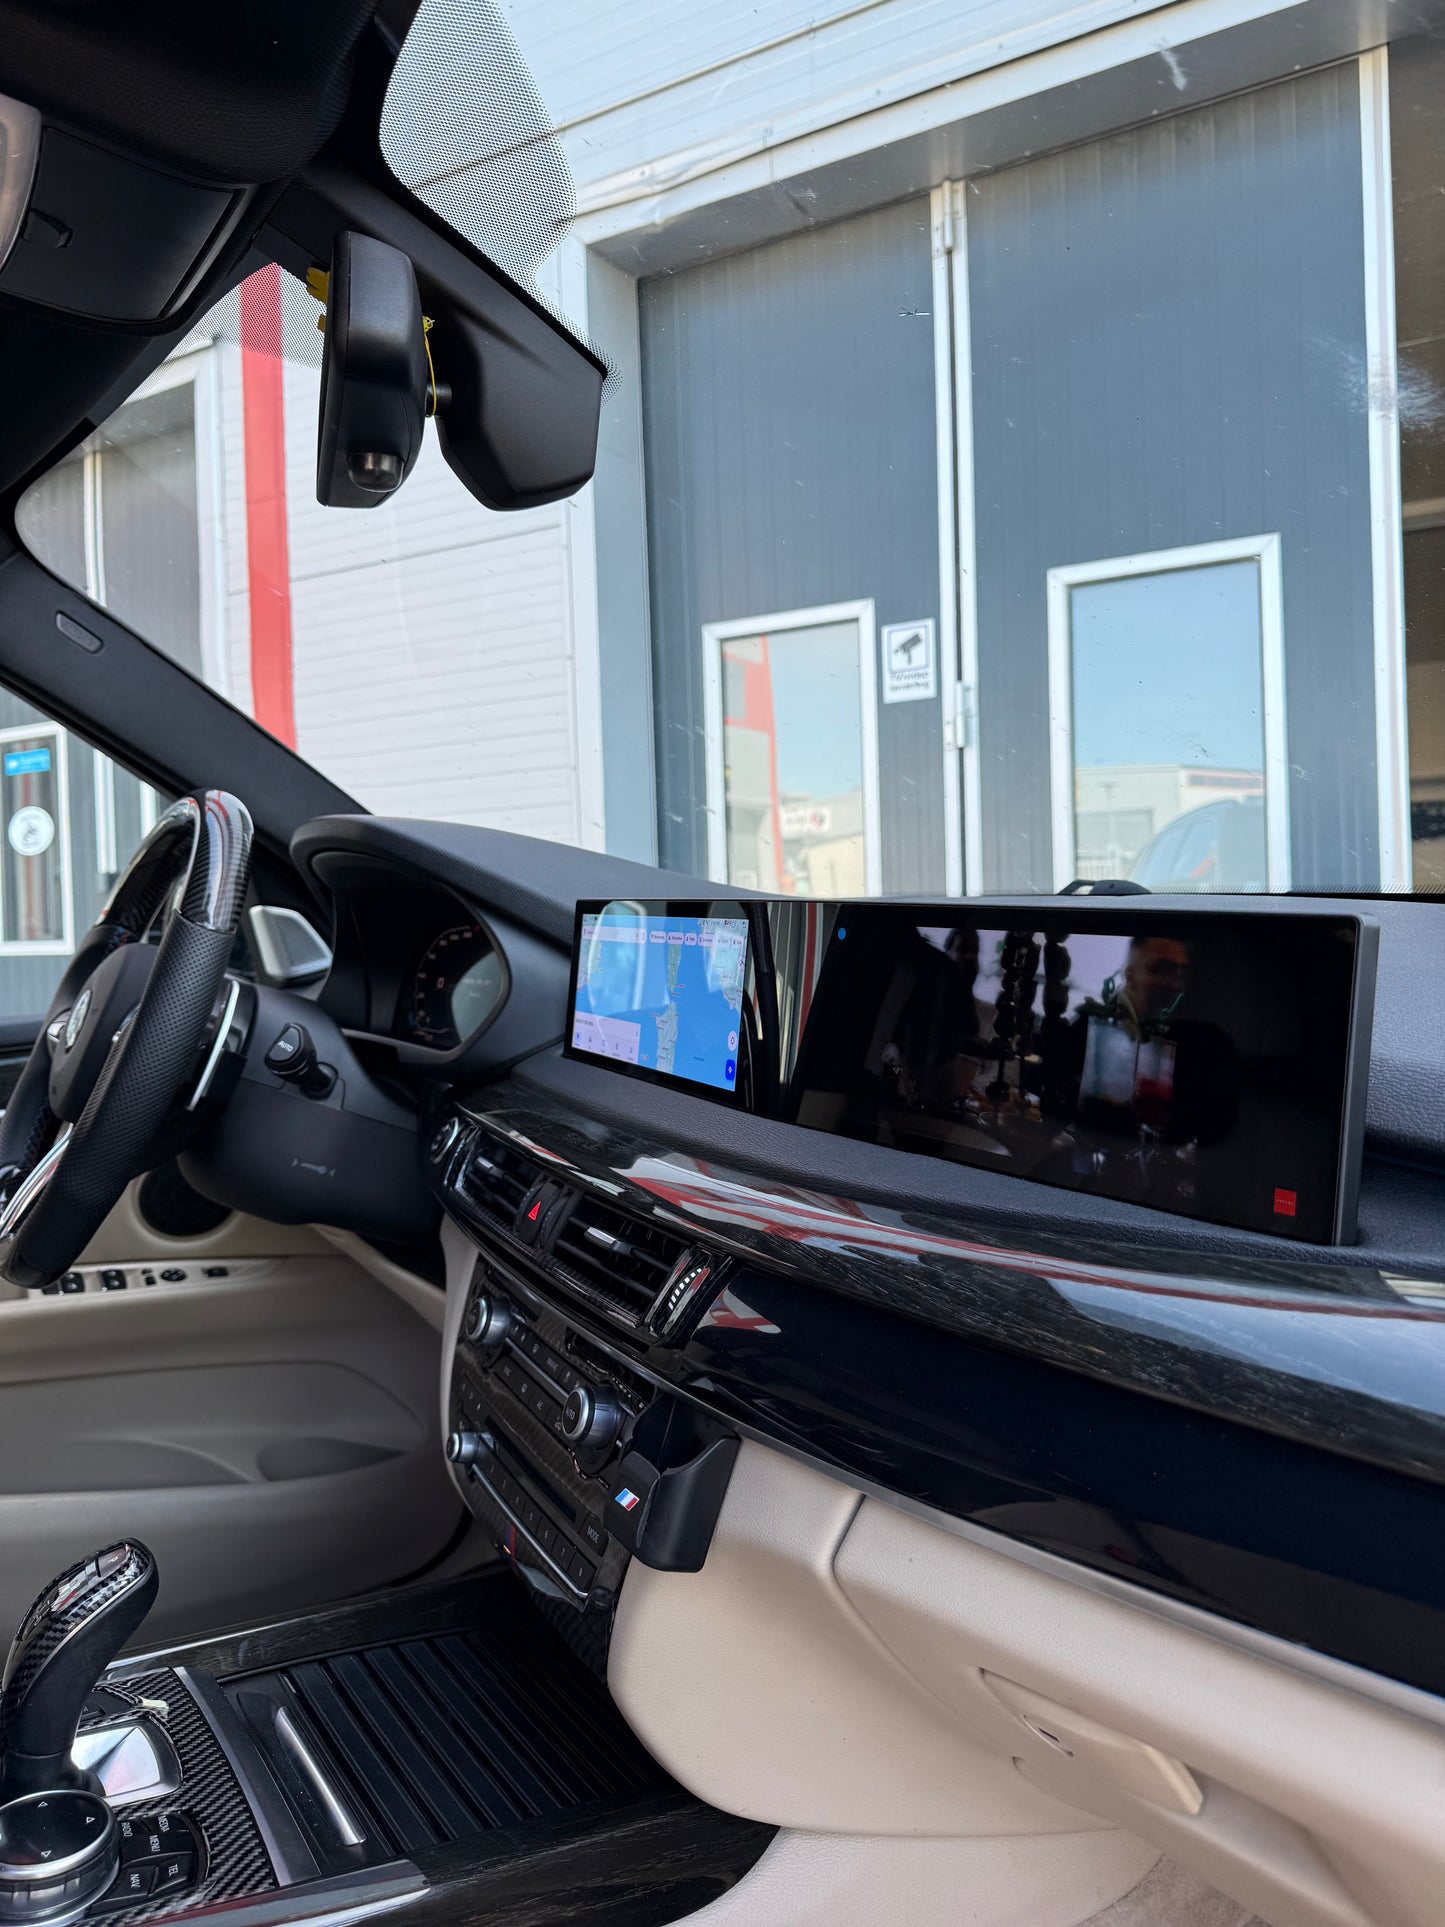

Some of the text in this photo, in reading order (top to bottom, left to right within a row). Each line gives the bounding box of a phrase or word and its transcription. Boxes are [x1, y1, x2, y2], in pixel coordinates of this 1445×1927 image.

[436, 977, 445, 989] 0
[278, 1040, 294, 1052] AUTO
[565, 1406, 576, 1420] AUTO
[587, 1525, 600, 1544] MODE
[121, 1822, 133, 1837] RADIO
[158, 1816, 170, 1832] MEDIA
[149, 1834, 161, 1852] MENU
[168, 1864, 179, 1877] TEL
[130, 1873, 141, 1888] NAV
